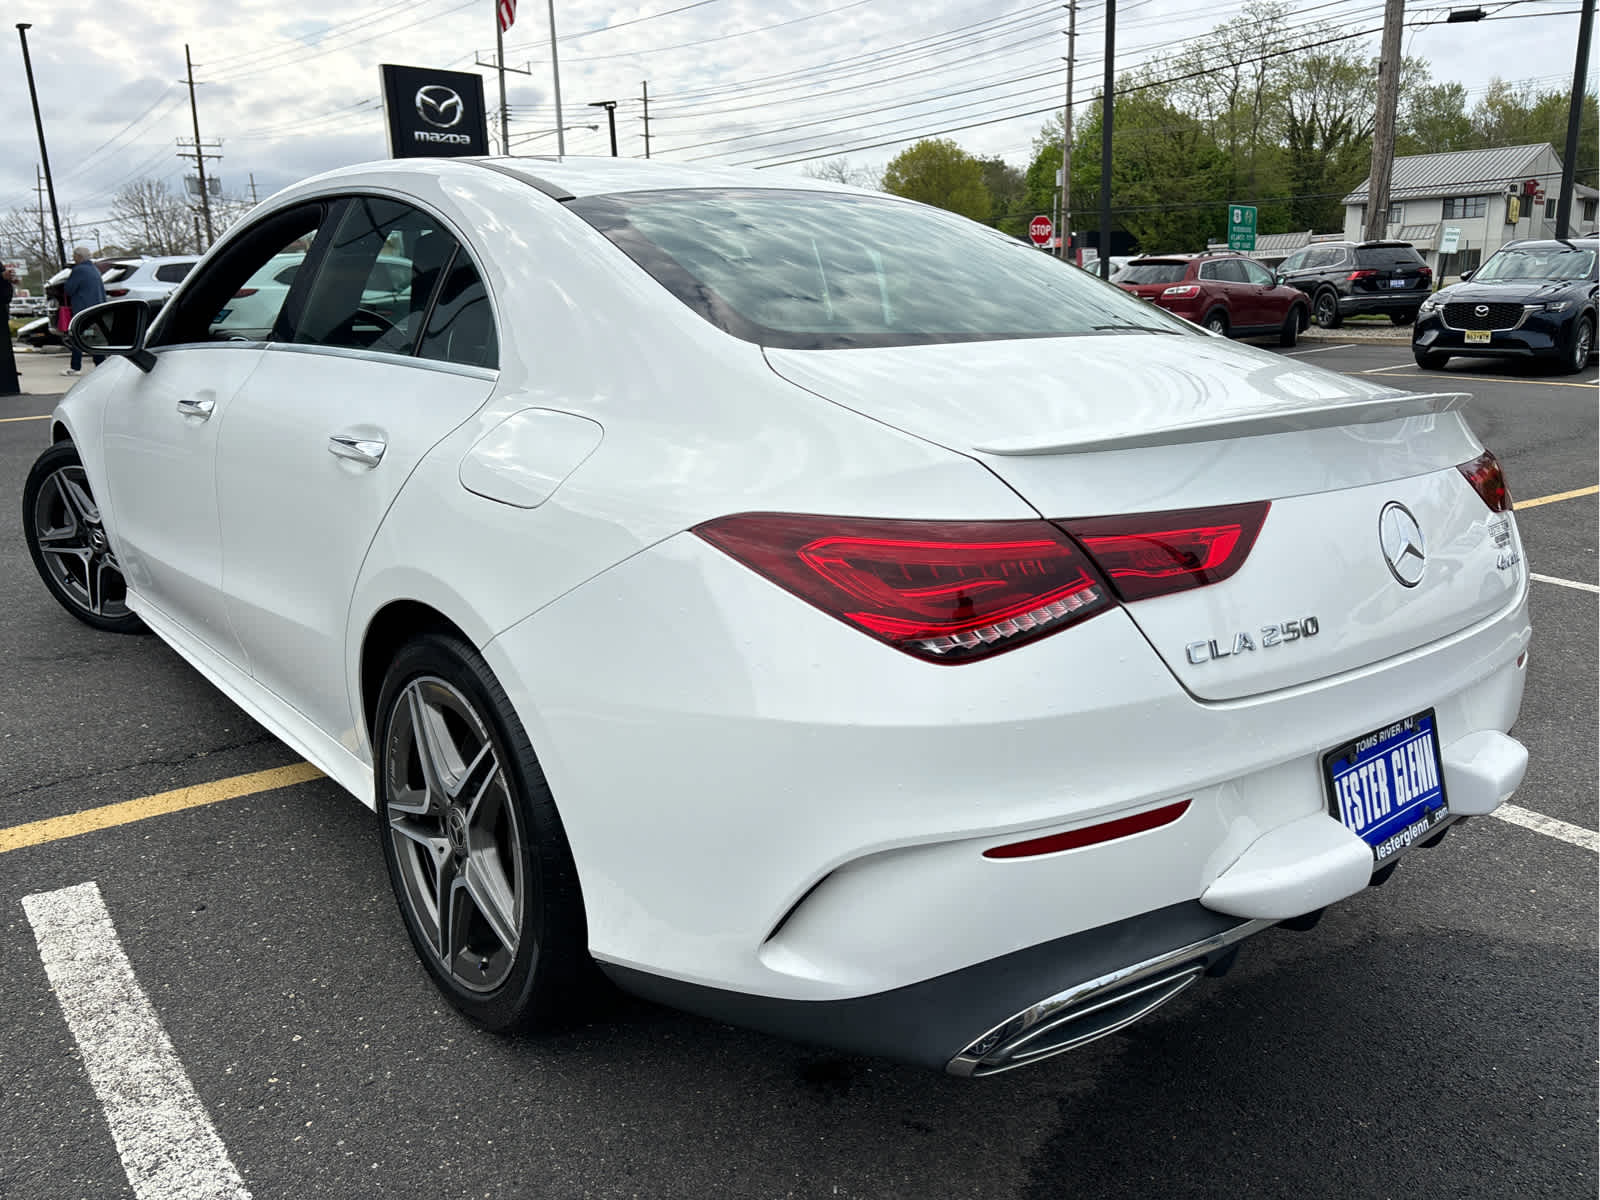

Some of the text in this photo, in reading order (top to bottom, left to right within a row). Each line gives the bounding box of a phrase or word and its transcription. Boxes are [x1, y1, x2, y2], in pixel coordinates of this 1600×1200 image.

[414, 131, 471, 144] mazda
[1031, 224, 1051, 236] STOP
[1185, 616, 1320, 665] CLA 250
[1355, 735, 1378, 754] TOMS
[1404, 717, 1414, 732] NJ
[1391, 733, 1438, 807] GLENN
